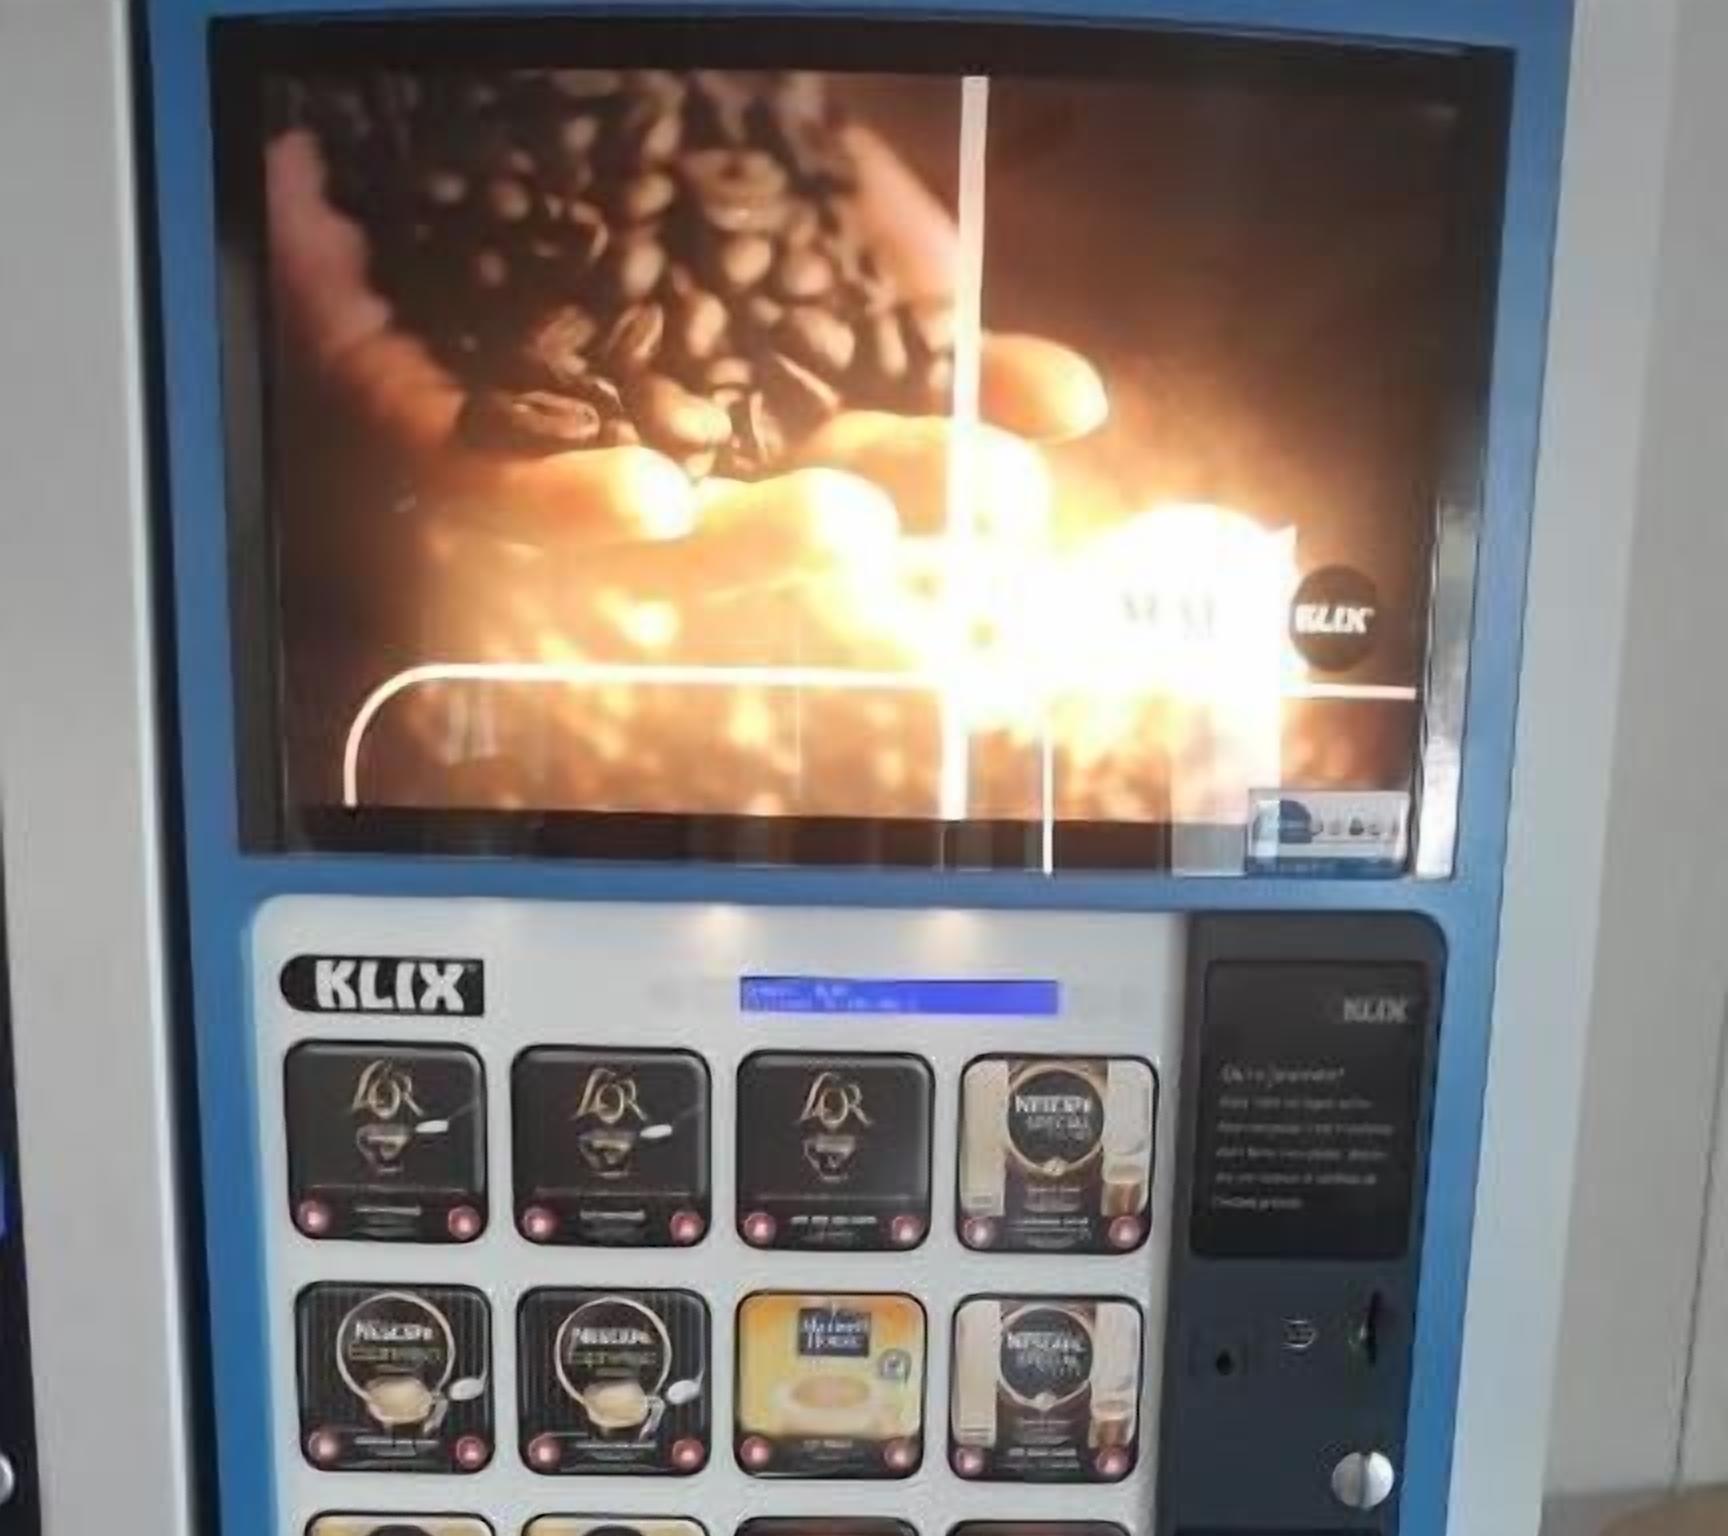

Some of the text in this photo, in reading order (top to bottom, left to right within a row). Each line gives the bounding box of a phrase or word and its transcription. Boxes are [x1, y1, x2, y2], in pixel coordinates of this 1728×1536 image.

[1296, 604, 1367, 633] KLIX
[315, 959, 465, 1012] KLIX
[1344, 998, 1407, 1023] KLIX
